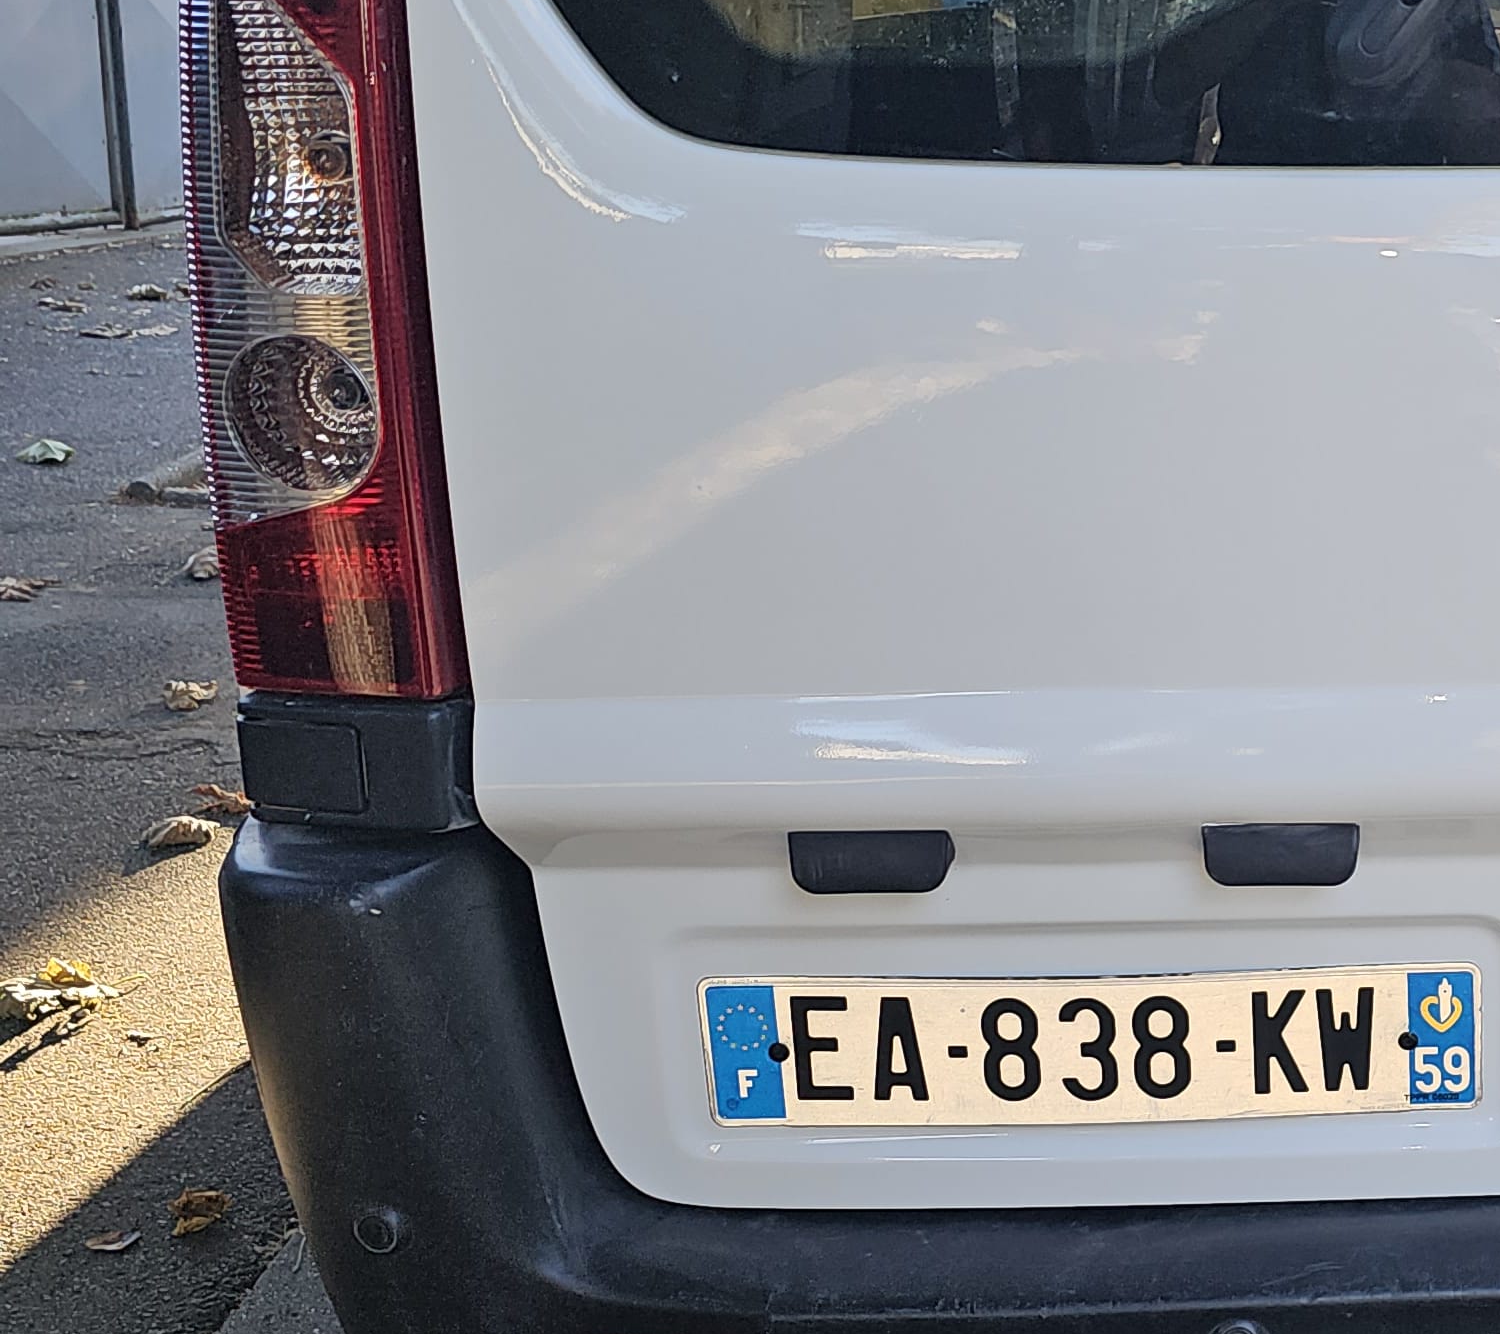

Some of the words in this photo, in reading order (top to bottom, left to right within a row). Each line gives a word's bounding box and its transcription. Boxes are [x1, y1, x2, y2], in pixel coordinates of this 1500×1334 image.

[737, 1069, 758, 1099] F
[788, 988, 1374, 1101] EA-838-KW
[1414, 1046, 1471, 1093] 59
